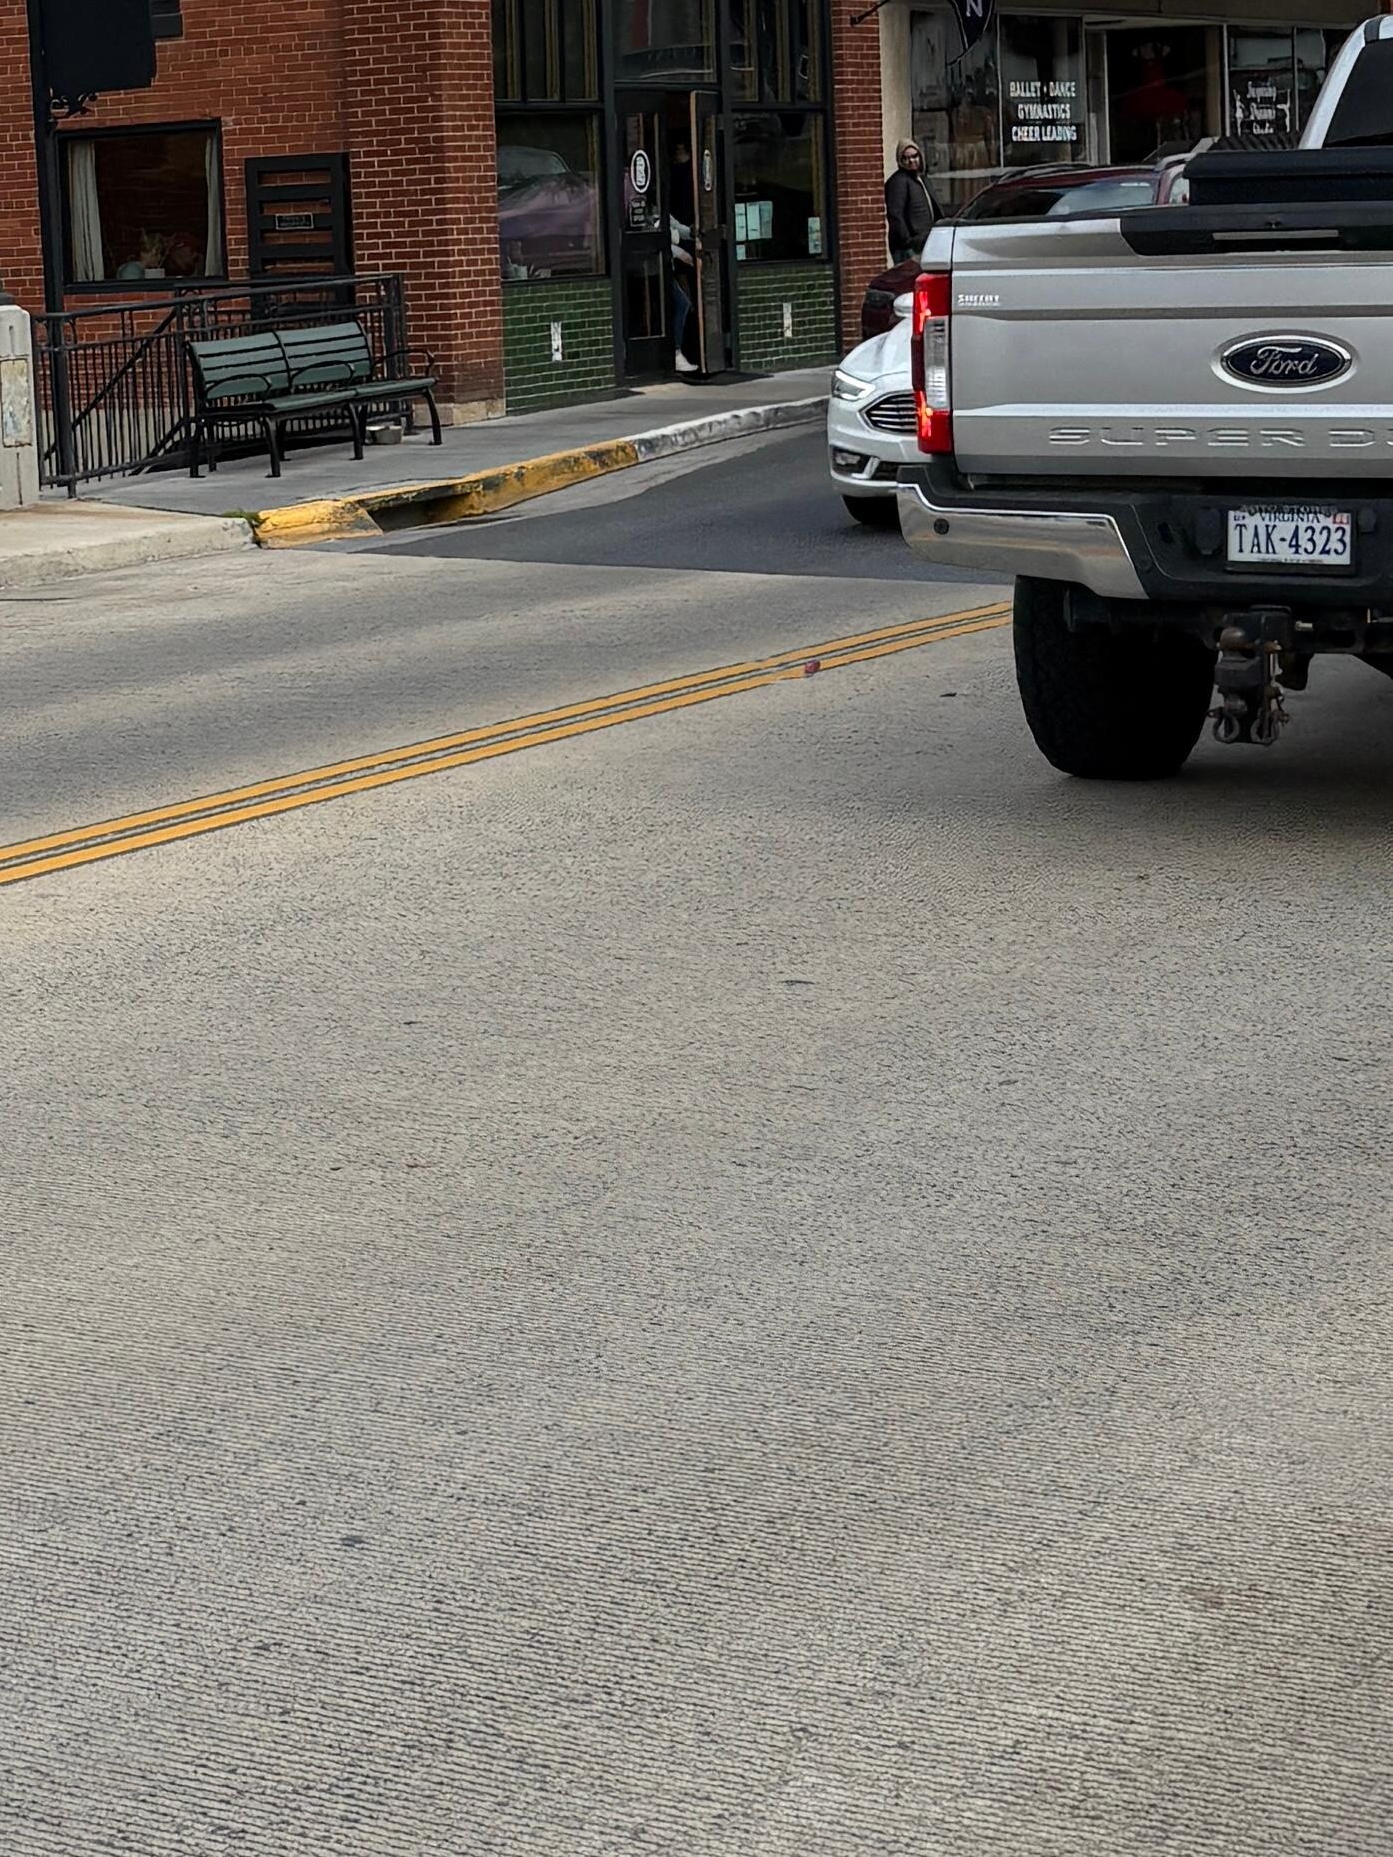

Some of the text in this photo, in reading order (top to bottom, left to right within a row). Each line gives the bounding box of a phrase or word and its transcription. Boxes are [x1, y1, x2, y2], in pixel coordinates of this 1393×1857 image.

[1009, 81, 1076, 97] BALLET DANCE
[1018, 103, 1070, 119] GYMNASTICS
[1012, 125, 1077, 141] CHEER LEADING
[1250, 346, 1319, 374] Ford
[1050, 427, 1393, 447] SUPER D
[1234, 523, 1347, 555] TAK-4323
